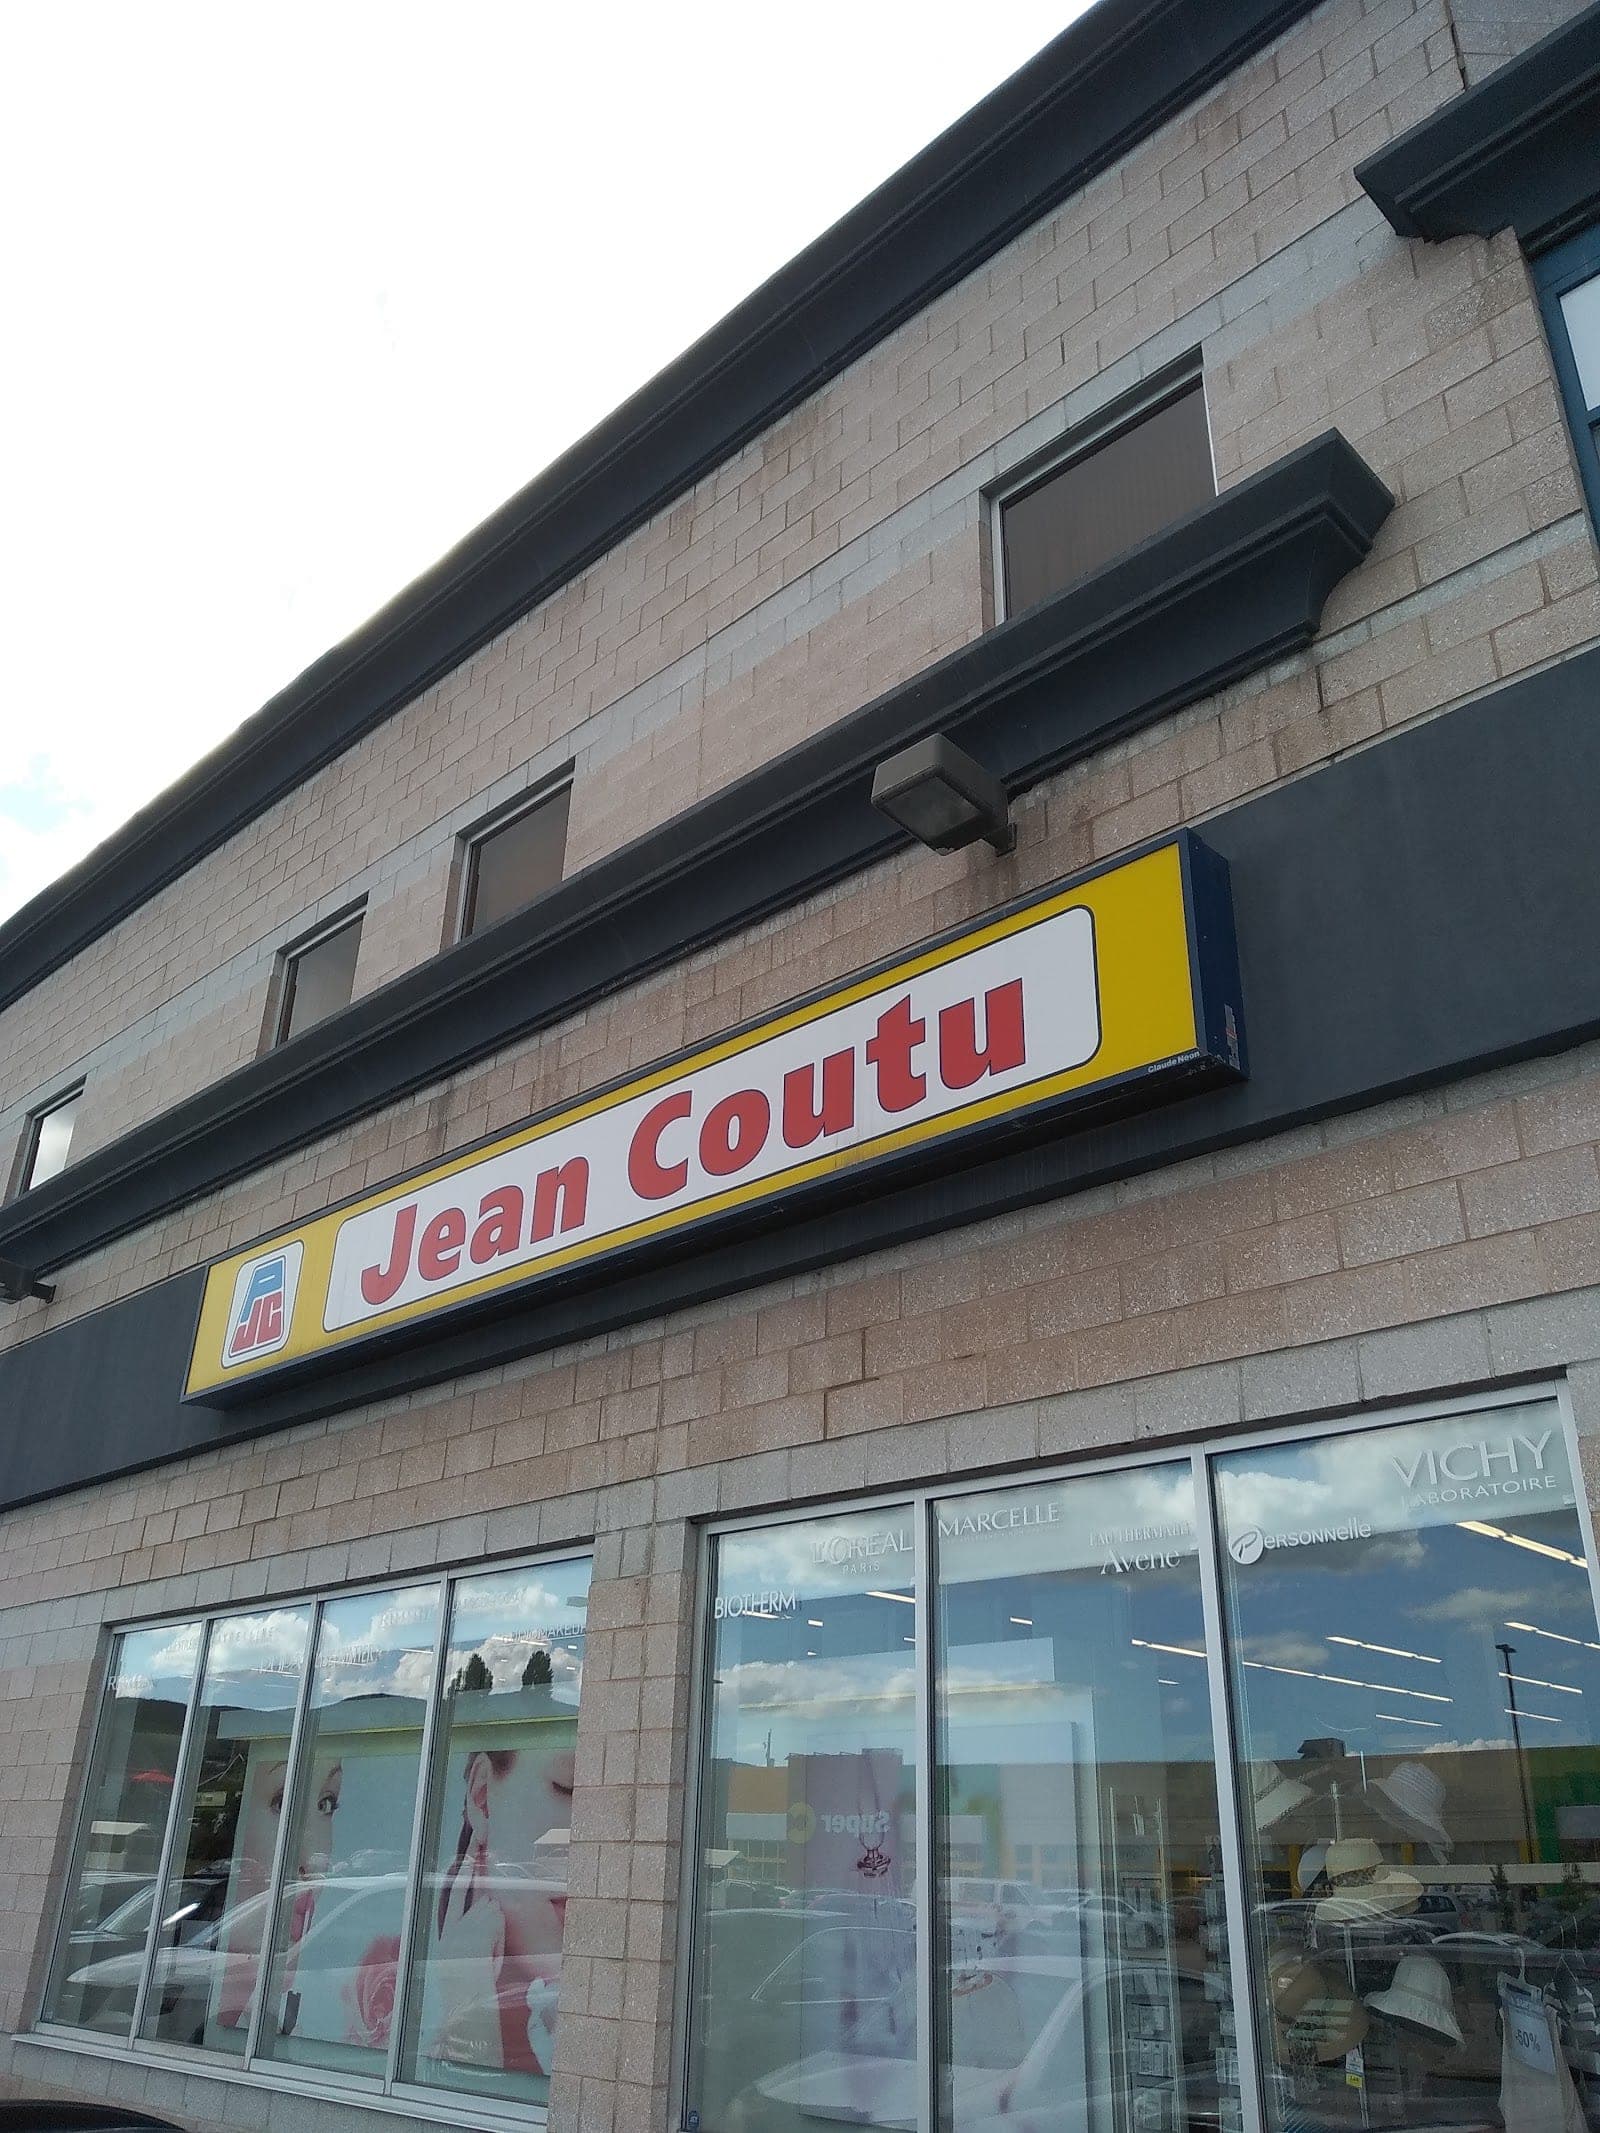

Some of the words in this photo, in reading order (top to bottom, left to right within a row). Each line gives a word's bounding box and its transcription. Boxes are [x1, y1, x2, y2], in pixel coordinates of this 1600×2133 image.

[1148, 1058, 1177, 1074] Claude
[1178, 1051, 1200, 1065] Neon
[361, 1156, 589, 1305] Jean
[628, 977, 1027, 1200] Coutu
[1392, 1430, 1553, 1488] VICHY
[939, 1502, 1060, 1537] MARCELLE
[715, 1587, 796, 1619] BIOTHERM
